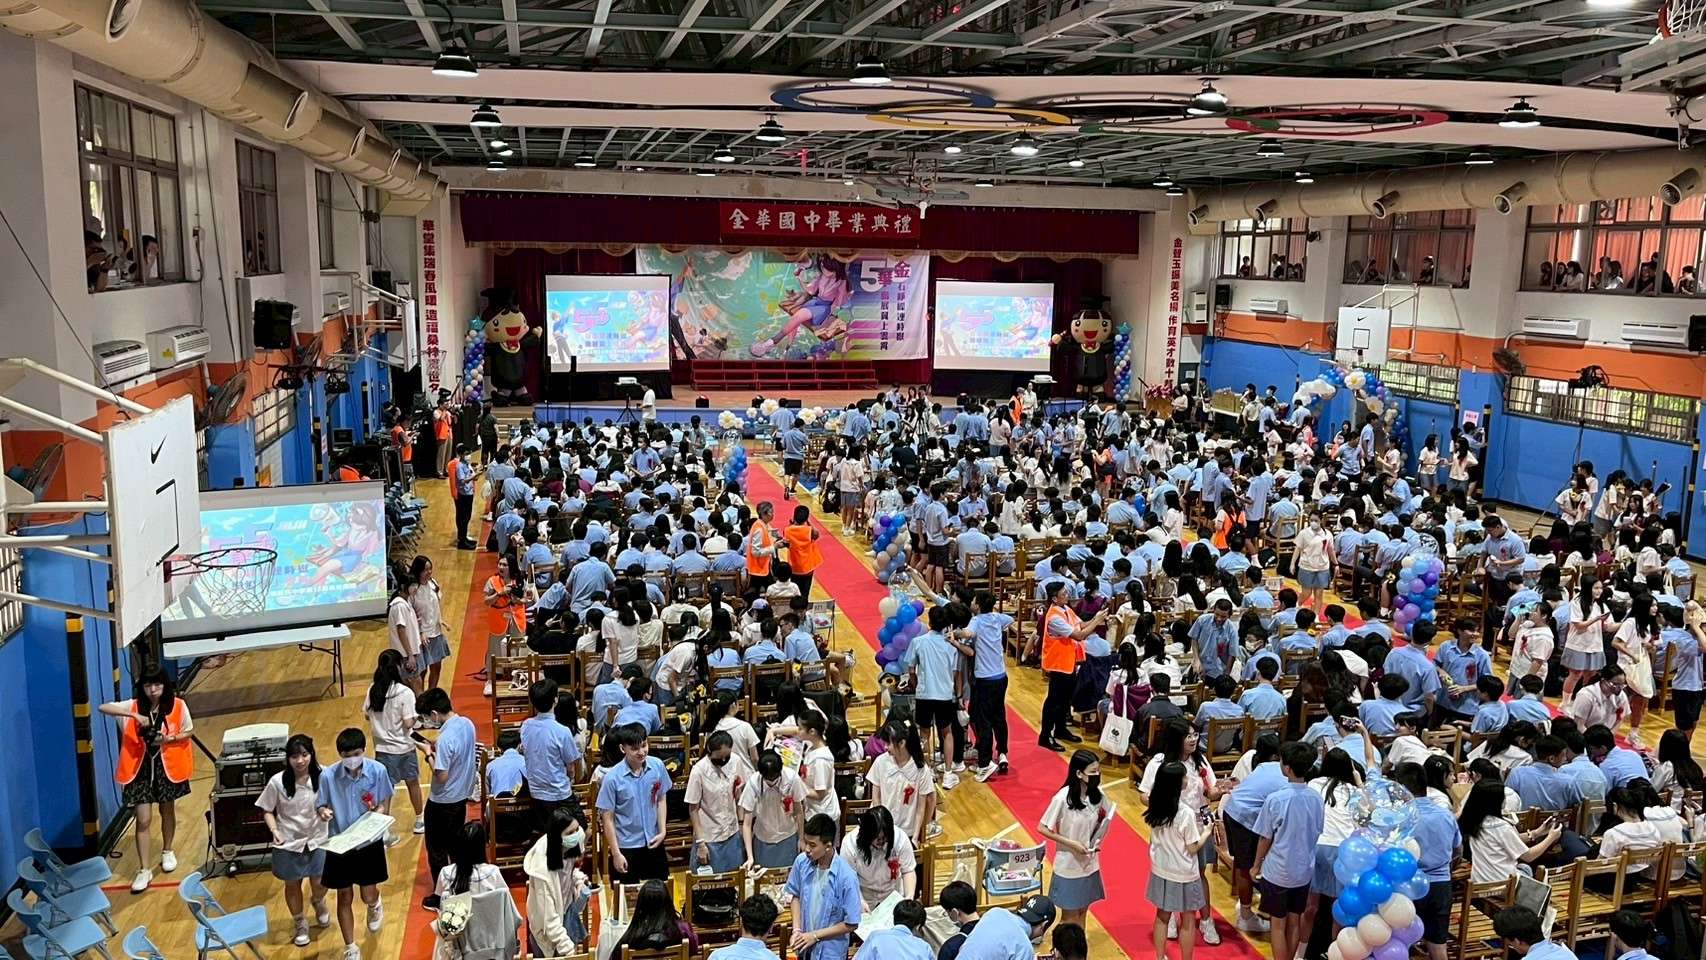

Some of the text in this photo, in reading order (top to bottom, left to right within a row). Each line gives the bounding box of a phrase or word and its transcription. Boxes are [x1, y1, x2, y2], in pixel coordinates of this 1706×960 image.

[728, 207, 913, 234] 金華國中畢業典禮
[1014, 854, 1031, 863] 923
